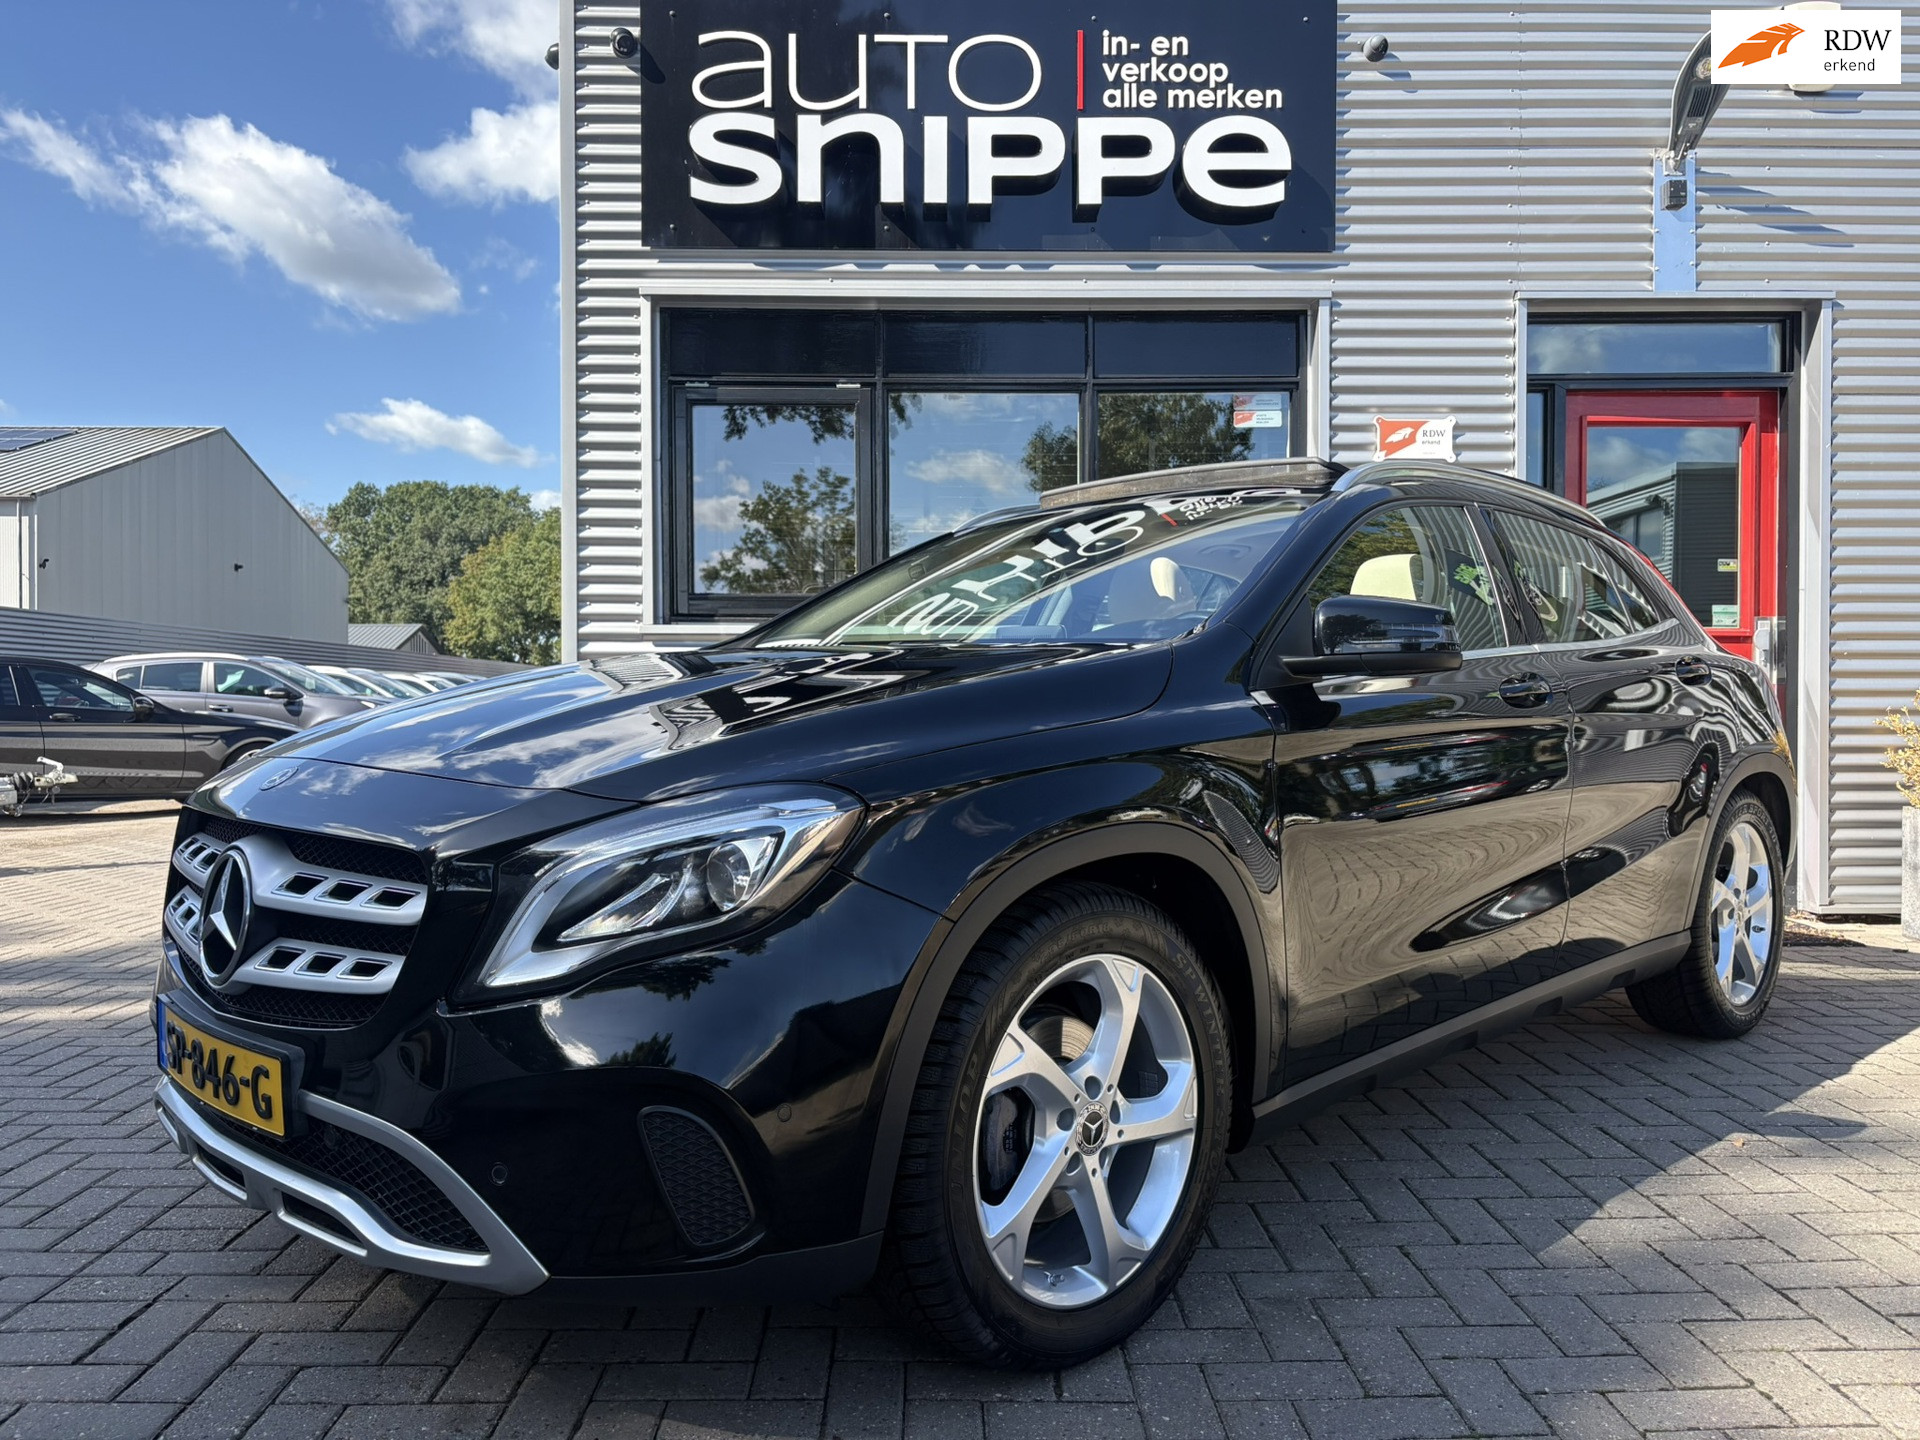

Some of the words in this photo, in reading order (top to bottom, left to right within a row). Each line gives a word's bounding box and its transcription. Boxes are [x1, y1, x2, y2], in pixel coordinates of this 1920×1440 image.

[1102, 29, 1140, 56] in-
[1151, 36, 1189, 56] en
[1102, 57, 1229, 88] verkoop
[1102, 83, 1158, 109] alle
[1167, 83, 1283, 109] merken
[1422, 429, 1446, 437] RDW
[166, 1020, 274, 1120] SP-846-G
